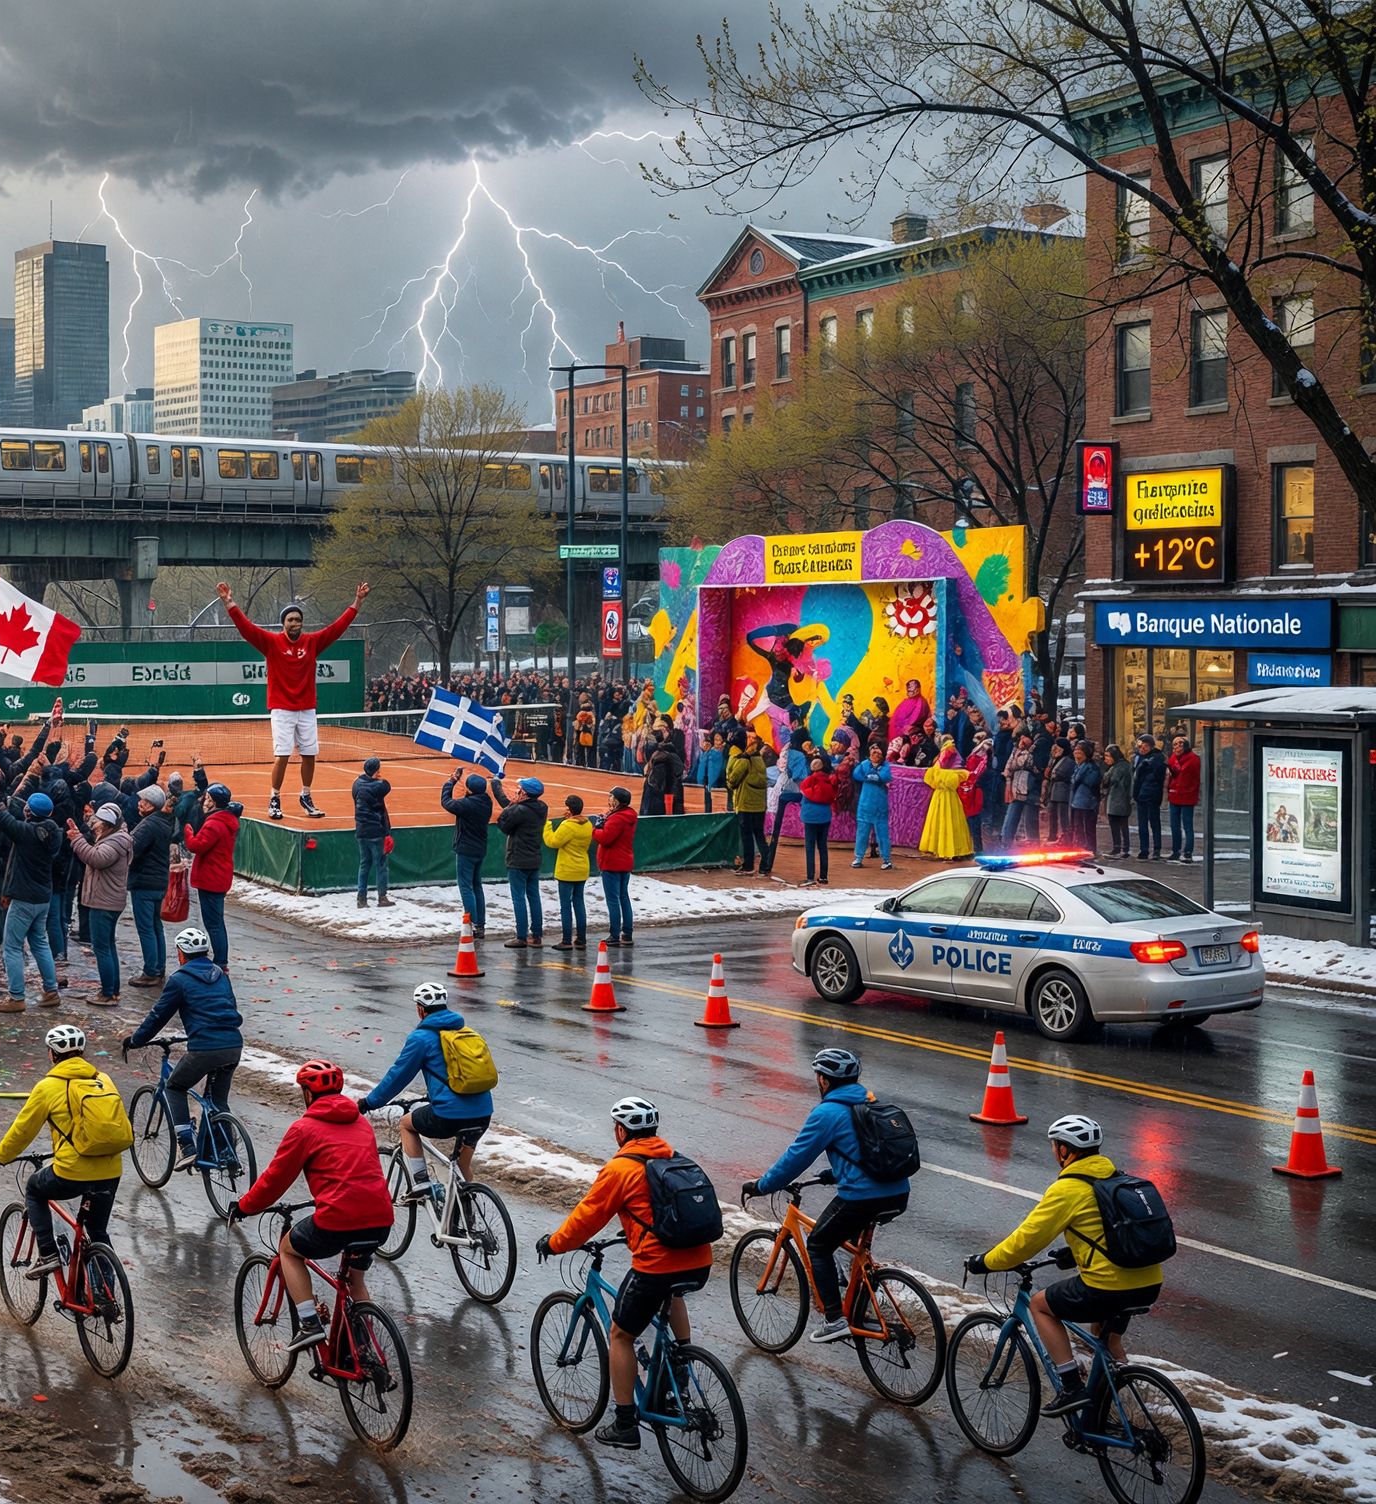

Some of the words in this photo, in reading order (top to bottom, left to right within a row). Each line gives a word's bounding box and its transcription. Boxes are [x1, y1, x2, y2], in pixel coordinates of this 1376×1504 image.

[1134, 536, 1215, 571] +12°C
[1136, 612, 1205, 638] Banque
[1210, 612, 1302, 635] Nationale
[932, 945, 1012, 976] POLICE
